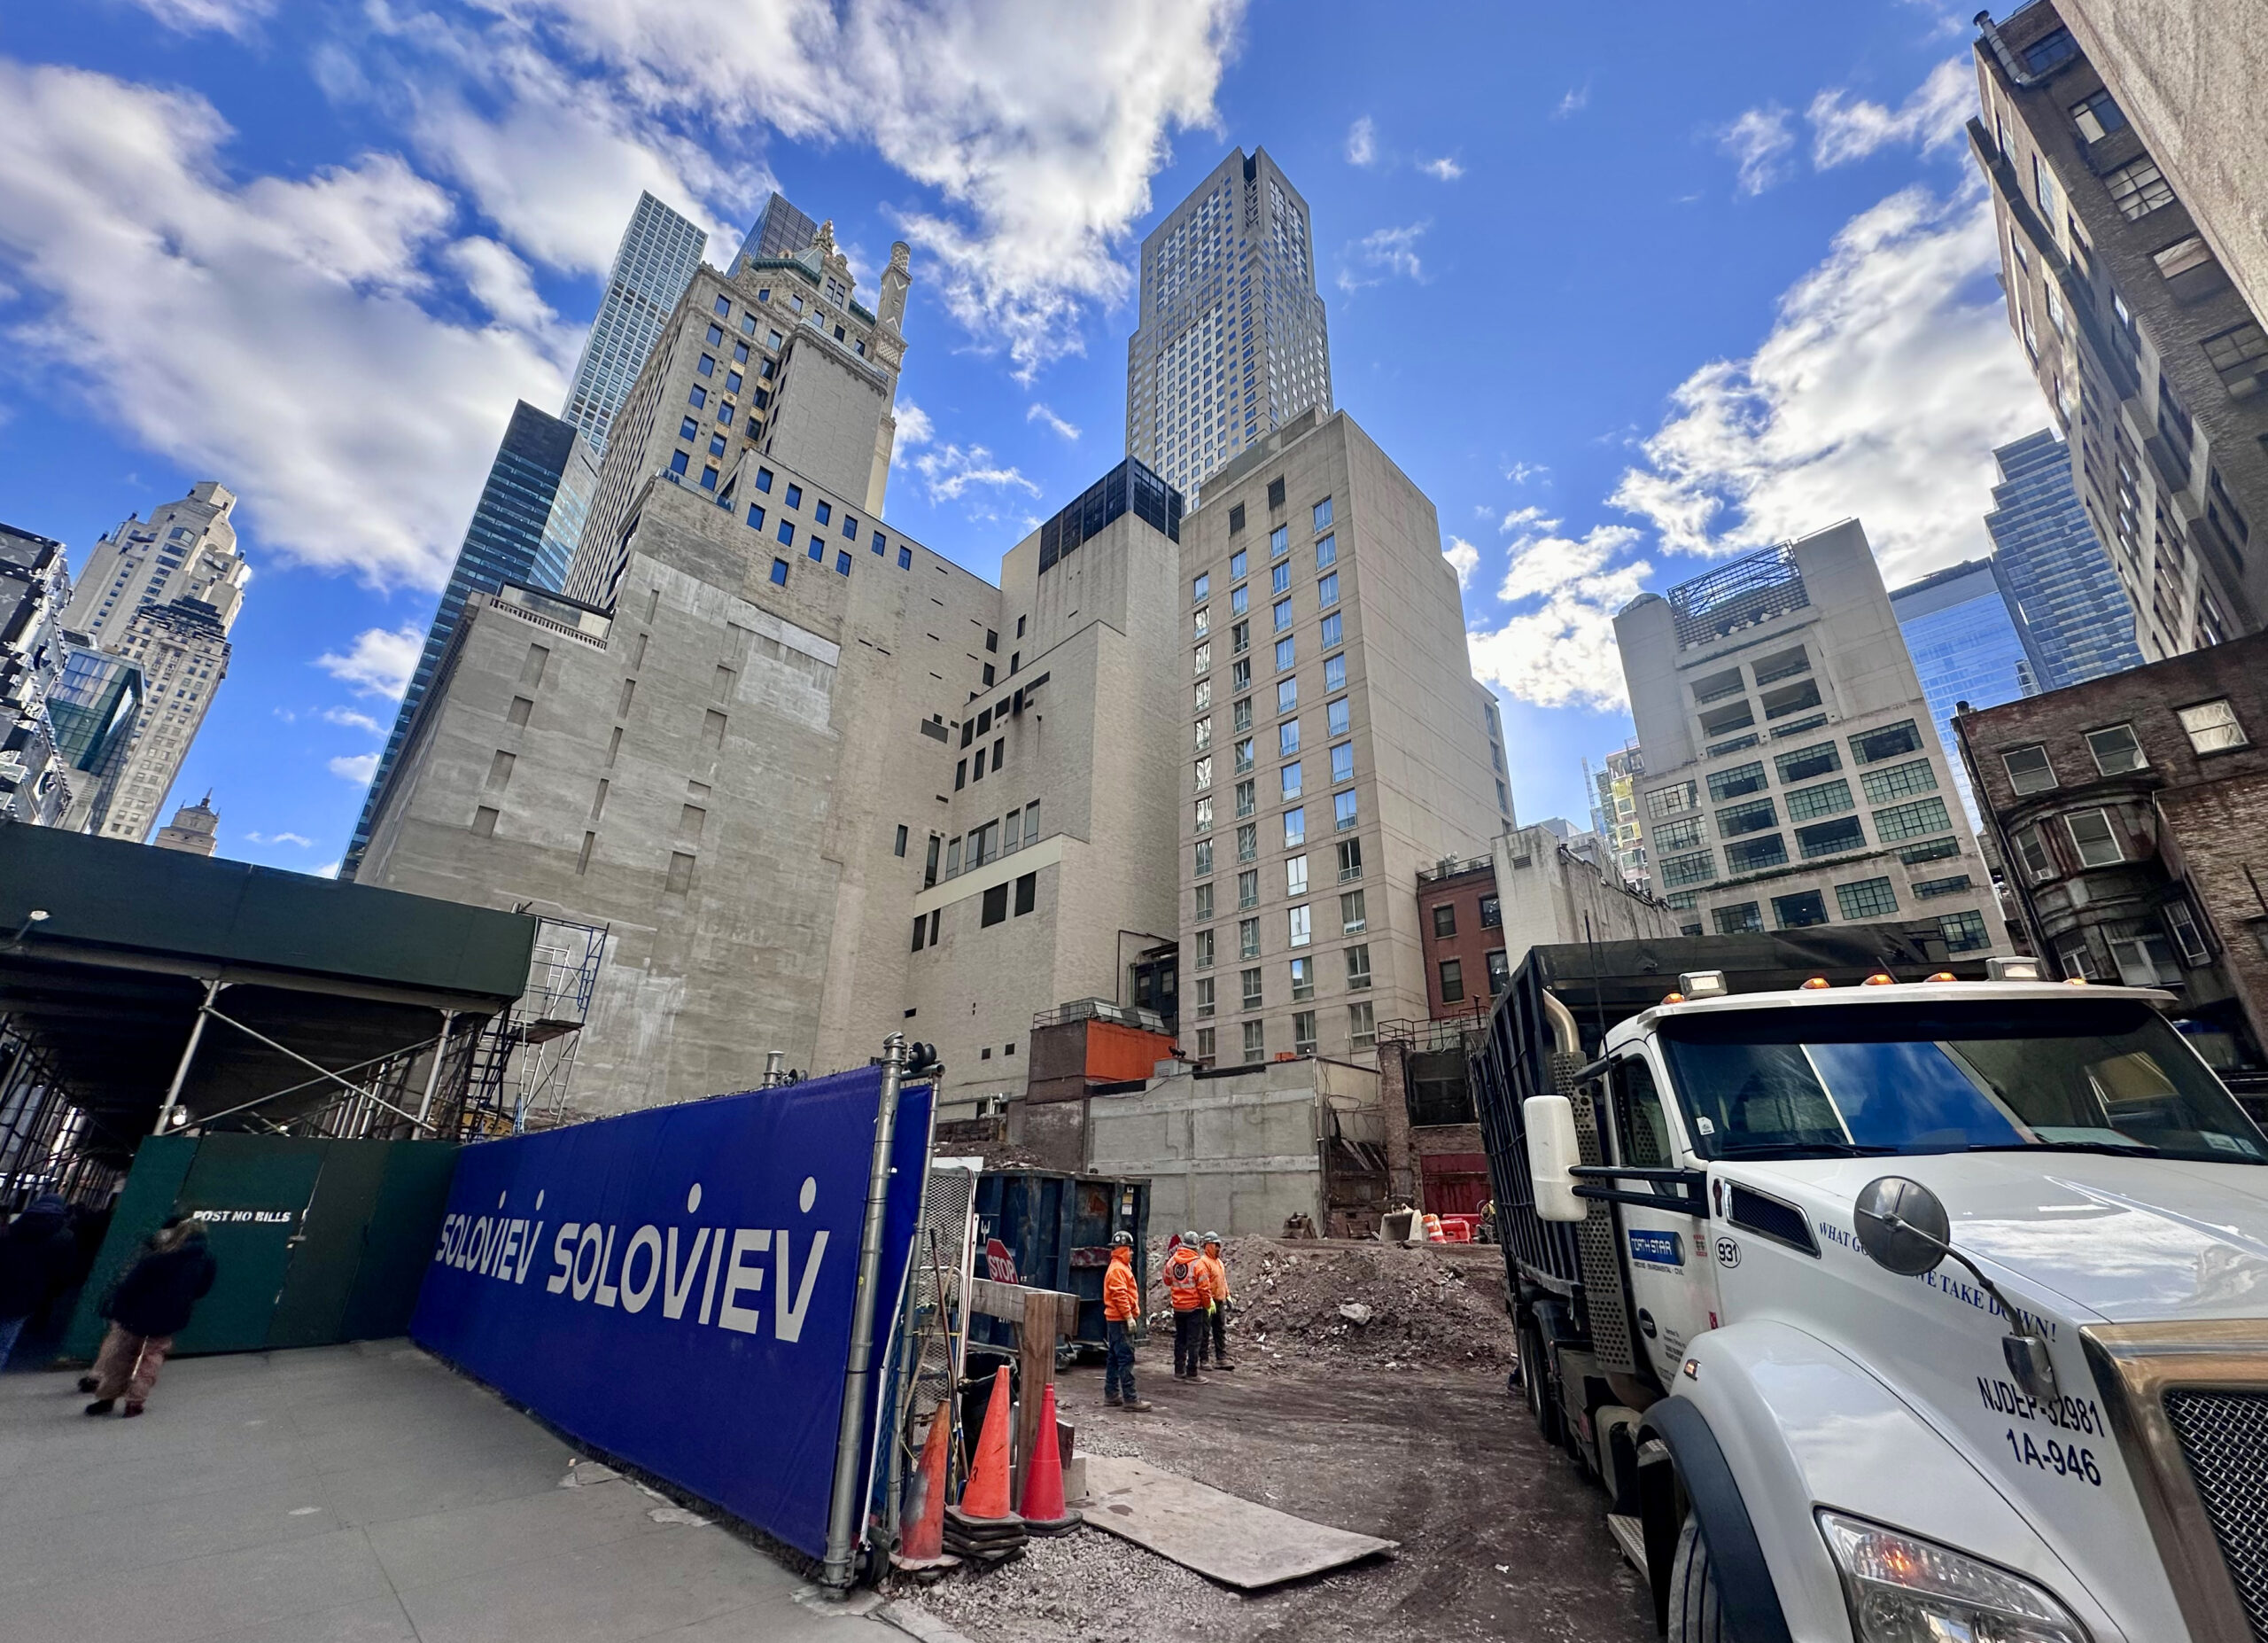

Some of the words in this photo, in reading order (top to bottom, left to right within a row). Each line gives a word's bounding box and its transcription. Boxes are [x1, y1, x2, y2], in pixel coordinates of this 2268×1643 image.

[193, 1211, 231, 1221] POST
[231, 1211, 252, 1222] NO
[254, 1211, 292, 1223] BILLS
[1651, 1239, 1673, 1256] STAR
[1719, 1242, 1738, 1263] 931
[435, 1213, 544, 1284] SOLOVIEV
[546, 1222, 830, 1343] SOLOVIEV
[988, 1255, 1015, 1283] STOP
[1819, 1222, 1851, 1248] WHAT
[1940, 1274, 1984, 1310] TAKE
[2006, 1429, 2102, 1488] 1A-946
